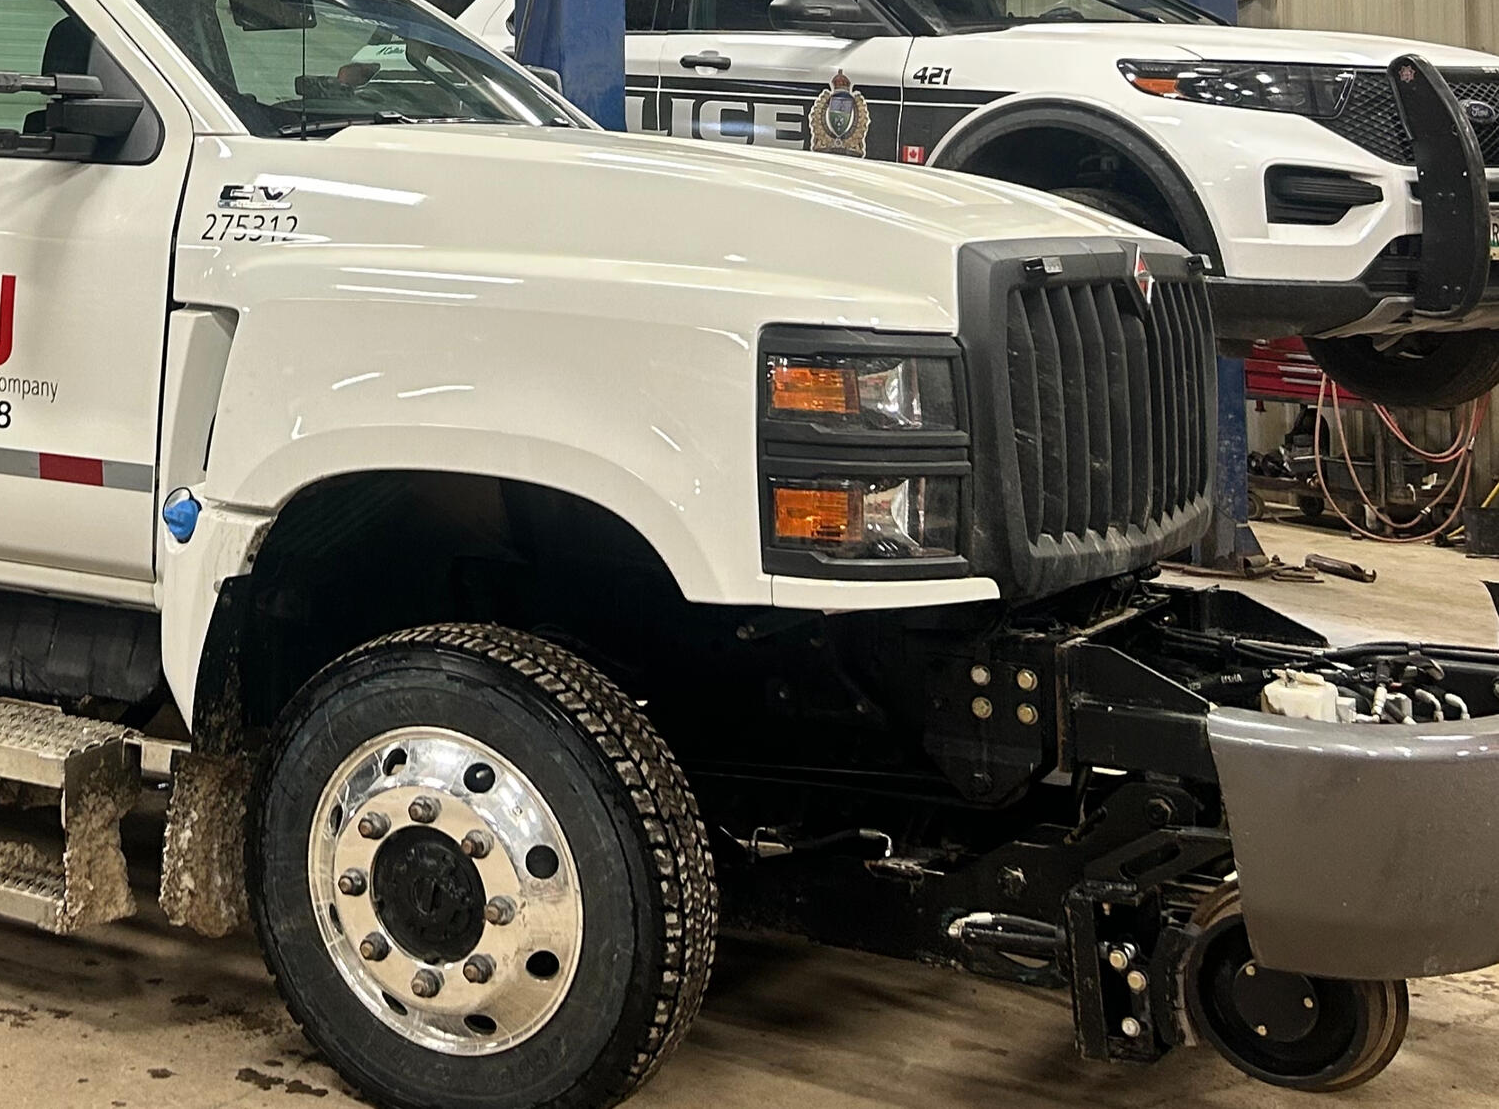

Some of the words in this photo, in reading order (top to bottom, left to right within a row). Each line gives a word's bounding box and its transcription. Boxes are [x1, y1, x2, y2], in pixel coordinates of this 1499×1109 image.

[912, 66, 953, 86] 421
[625, 95, 806, 151] LICE
[201, 213, 298, 242] 275312
